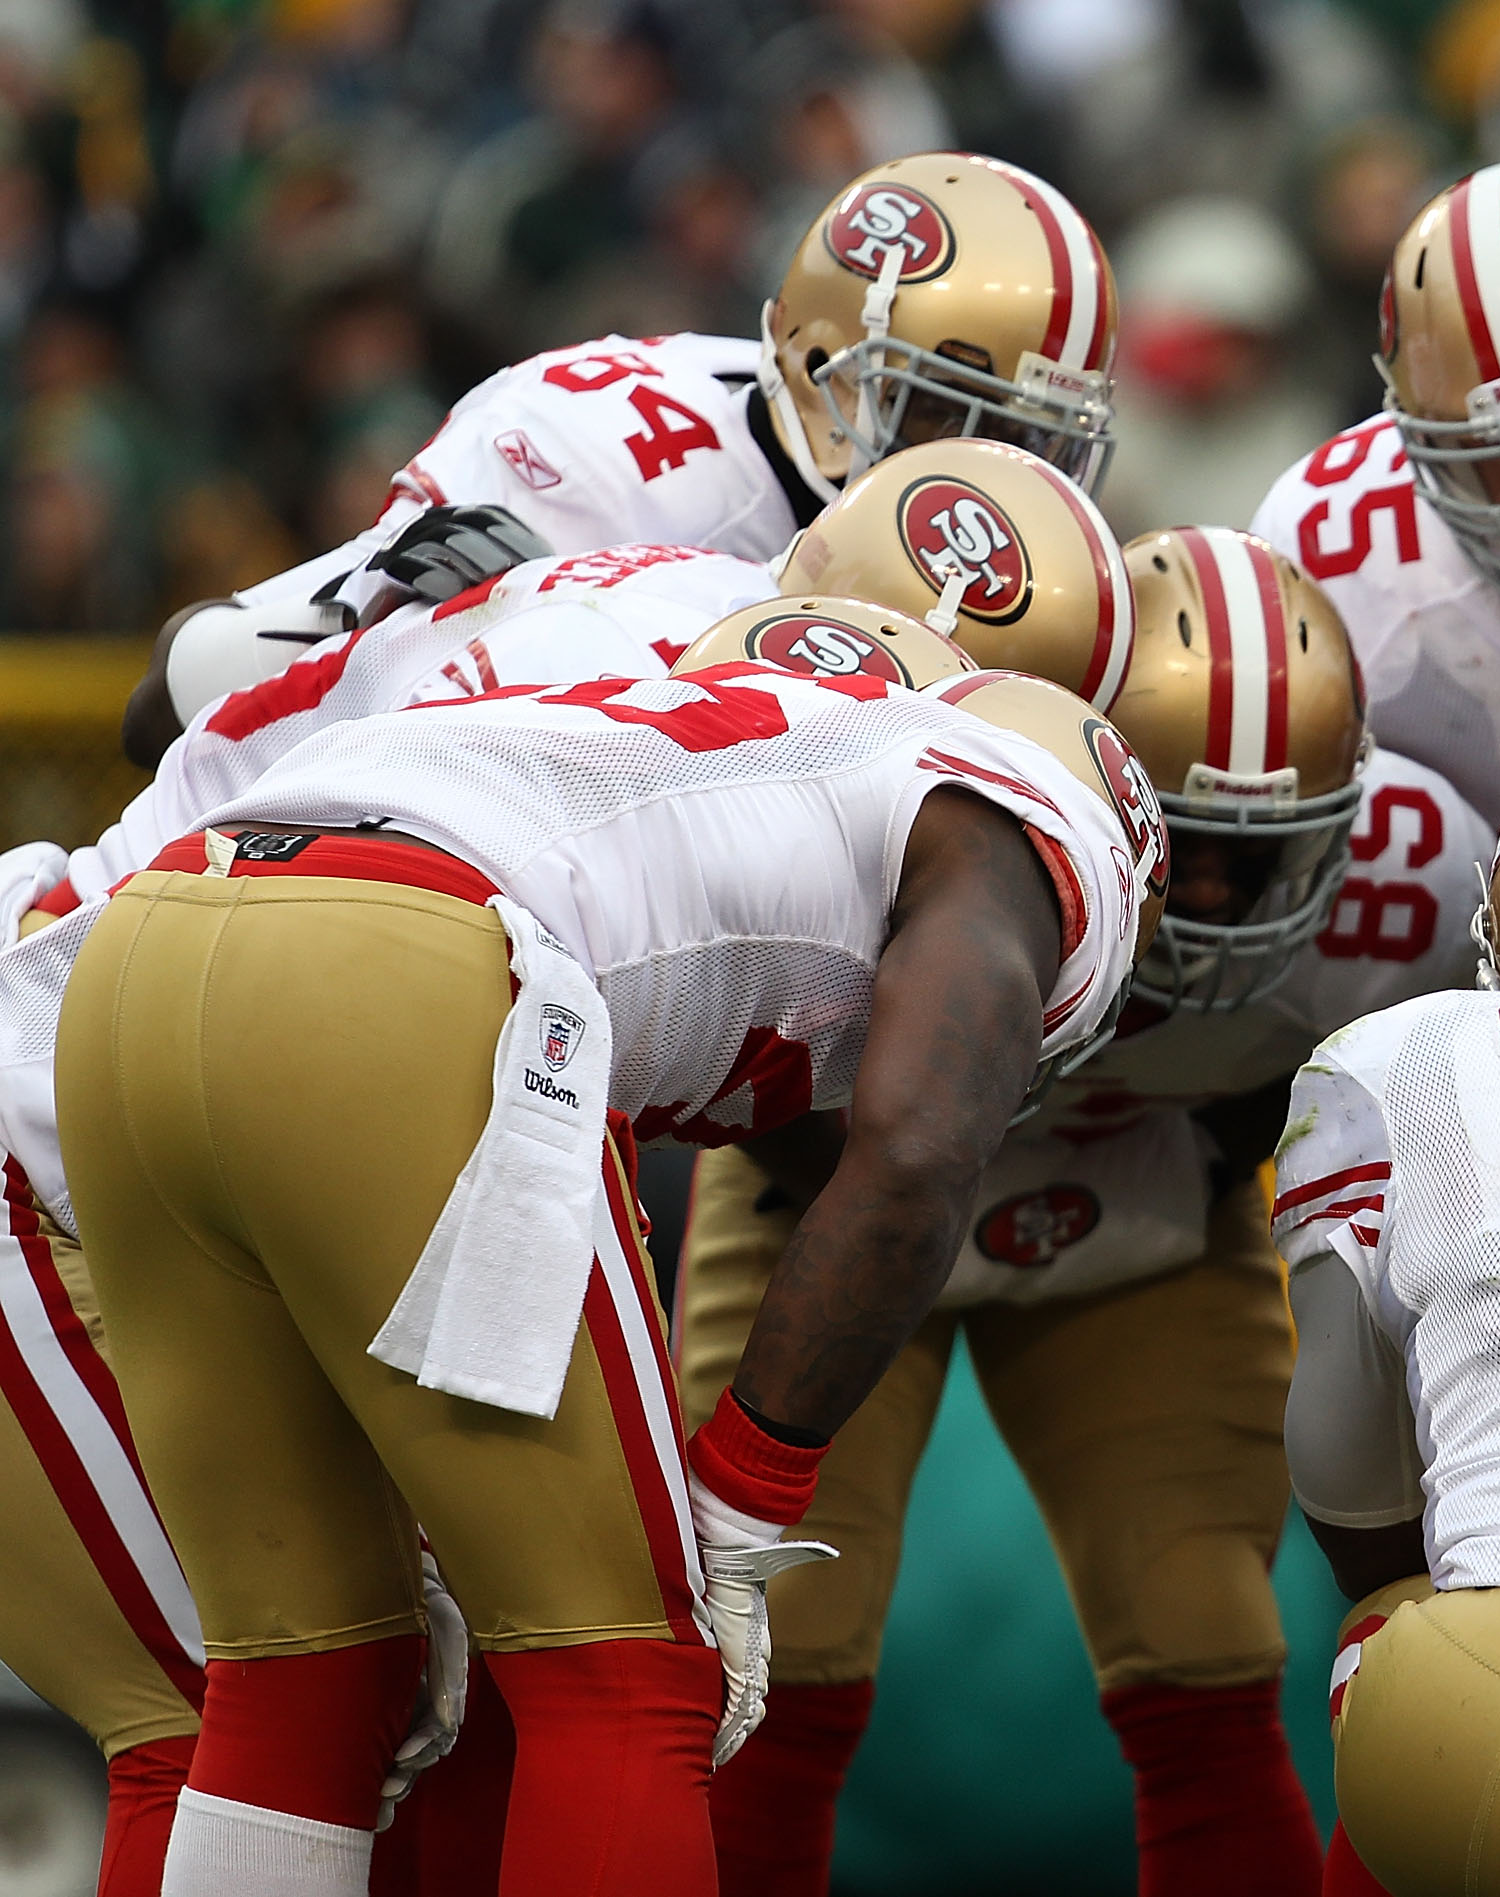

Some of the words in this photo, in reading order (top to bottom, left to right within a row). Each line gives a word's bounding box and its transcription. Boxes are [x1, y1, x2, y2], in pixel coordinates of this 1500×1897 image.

[543, 353, 722, 482] 84
[1298, 420, 1421, 580] 65
[1315, 783, 1443, 964] 85
[524, 1067, 579, 1109] Wilson
